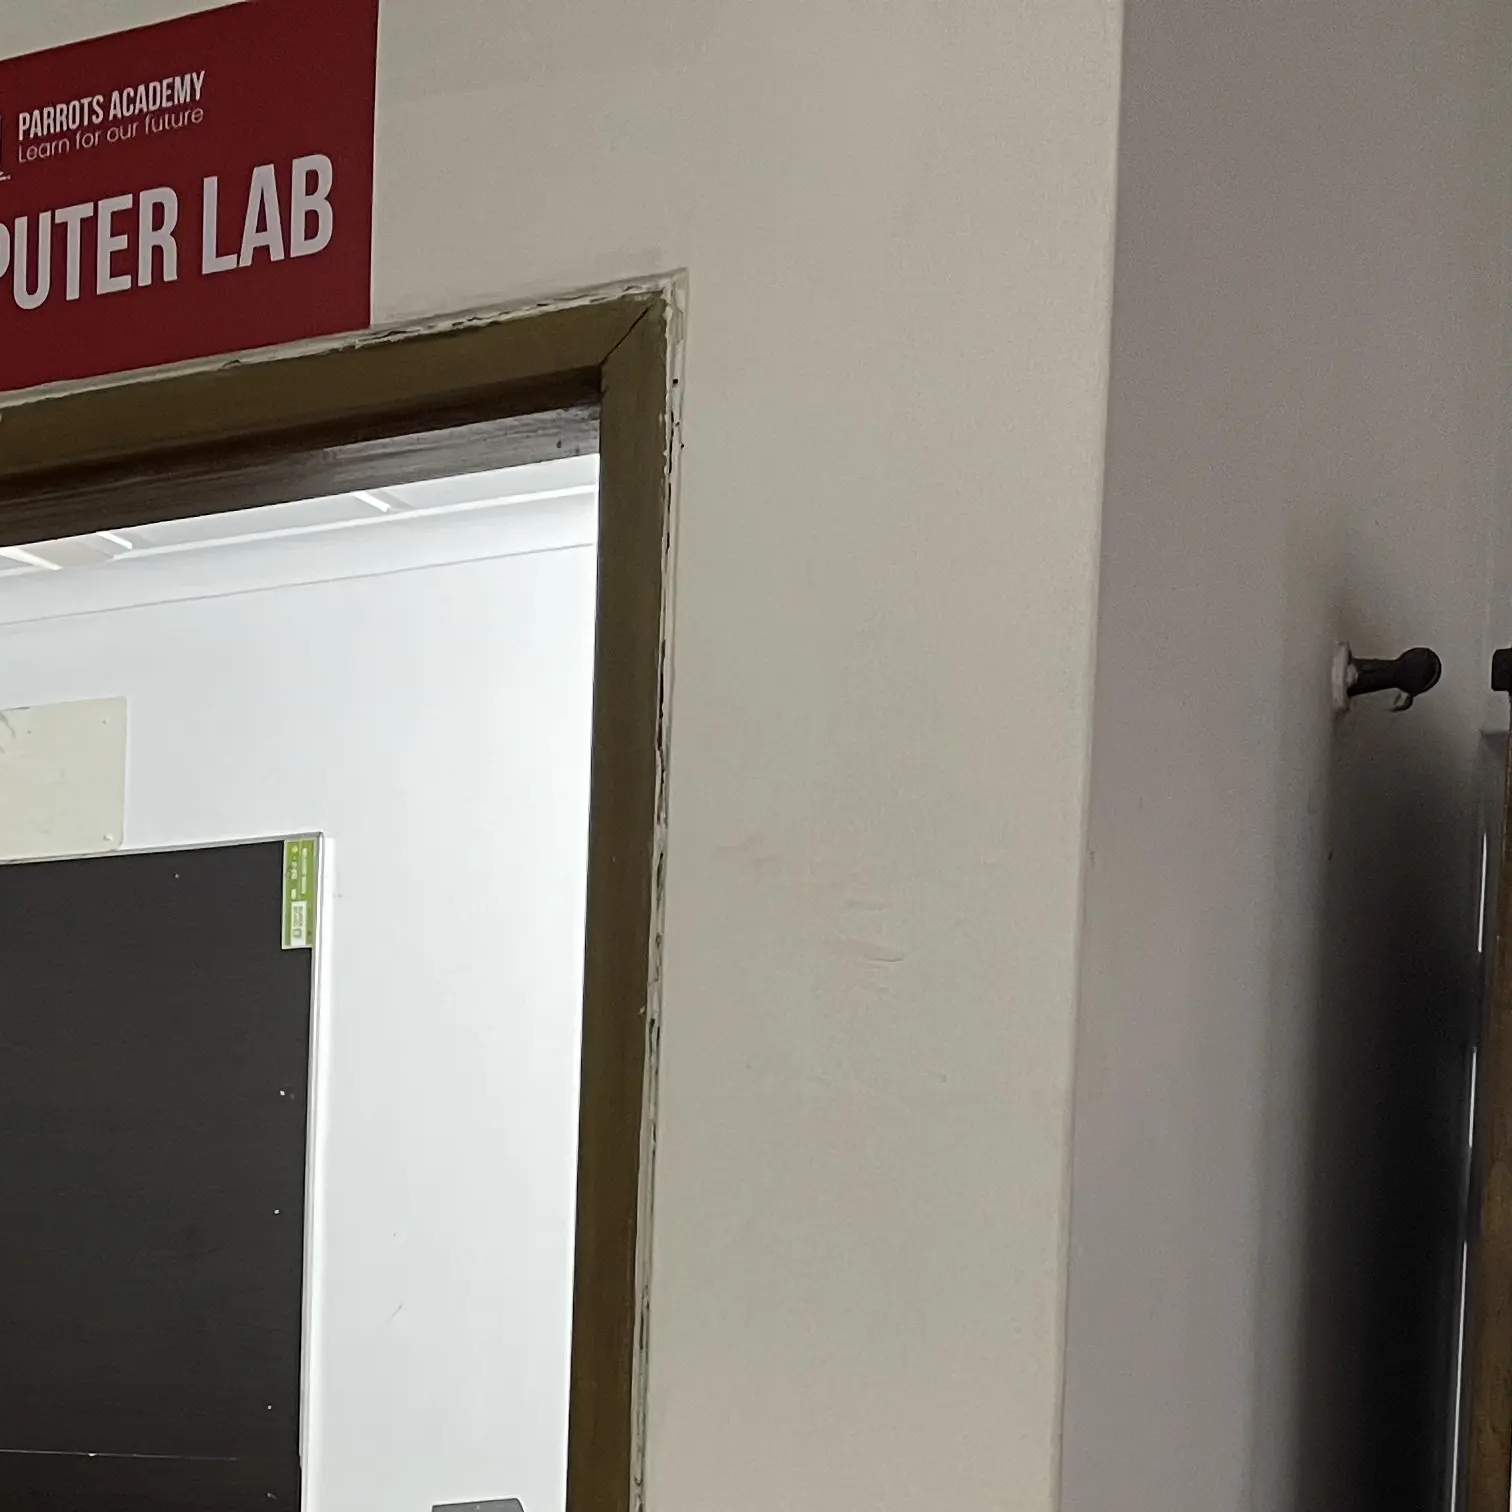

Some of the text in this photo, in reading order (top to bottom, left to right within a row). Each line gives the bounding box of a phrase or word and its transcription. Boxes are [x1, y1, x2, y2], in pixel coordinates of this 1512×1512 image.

[18, 70, 205, 141] PARROTS ACADEMY
[18, 107, 204, 163] Learn for our future
[201, 153, 334, 275] LAB
